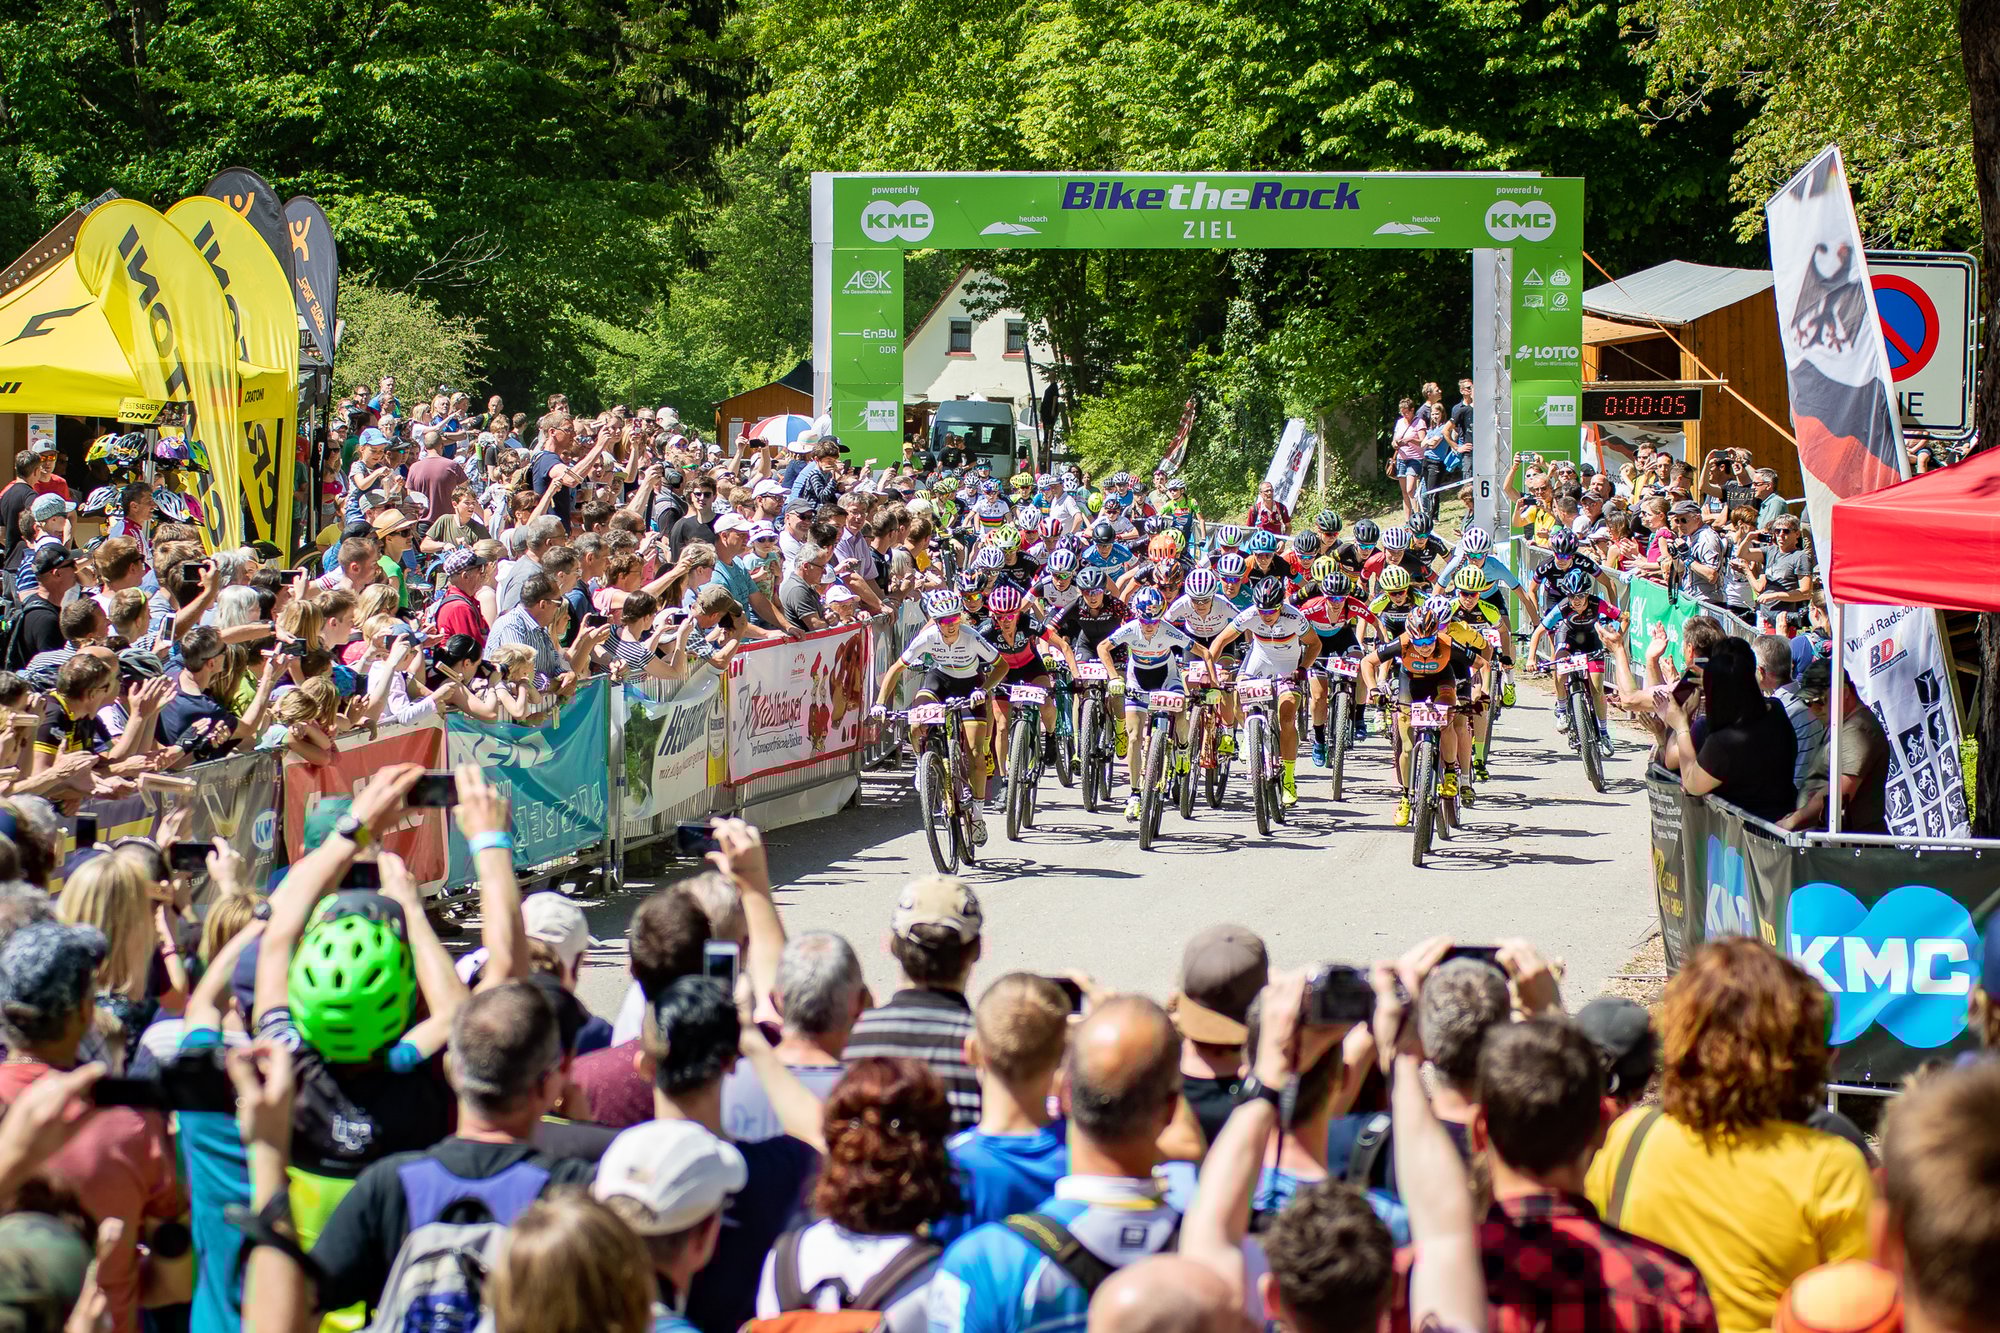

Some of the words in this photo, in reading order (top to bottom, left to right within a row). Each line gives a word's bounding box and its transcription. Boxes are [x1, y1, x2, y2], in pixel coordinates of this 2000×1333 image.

[871, 185, 908, 196] powered
[909, 185, 920, 196] by
[1496, 186, 1532, 196] powered
[1533, 186, 1543, 196] by
[867, 213, 929, 229] KMC
[1018, 215, 1048, 223] heubach
[1411, 215, 1441, 223] heubach
[1491, 213, 1552, 229] KMC
[1183, 221, 1237, 239] ZIEL
[844, 270, 892, 289] AOK
[863, 328, 897, 339] EnBW
[879, 346, 897, 354] ODR
[1534, 346, 1579, 359] LOTTO
[1549, 404, 1574, 412] MTB
[1605, 395, 1687, 416] 0:00:05
[869, 409, 895, 418] MTB
[1481, 480, 1490, 498] 6
[1247, 687, 1273, 698] 103
[1158, 695, 1183, 708] 100
[1791, 933, 1971, 996] KMC
